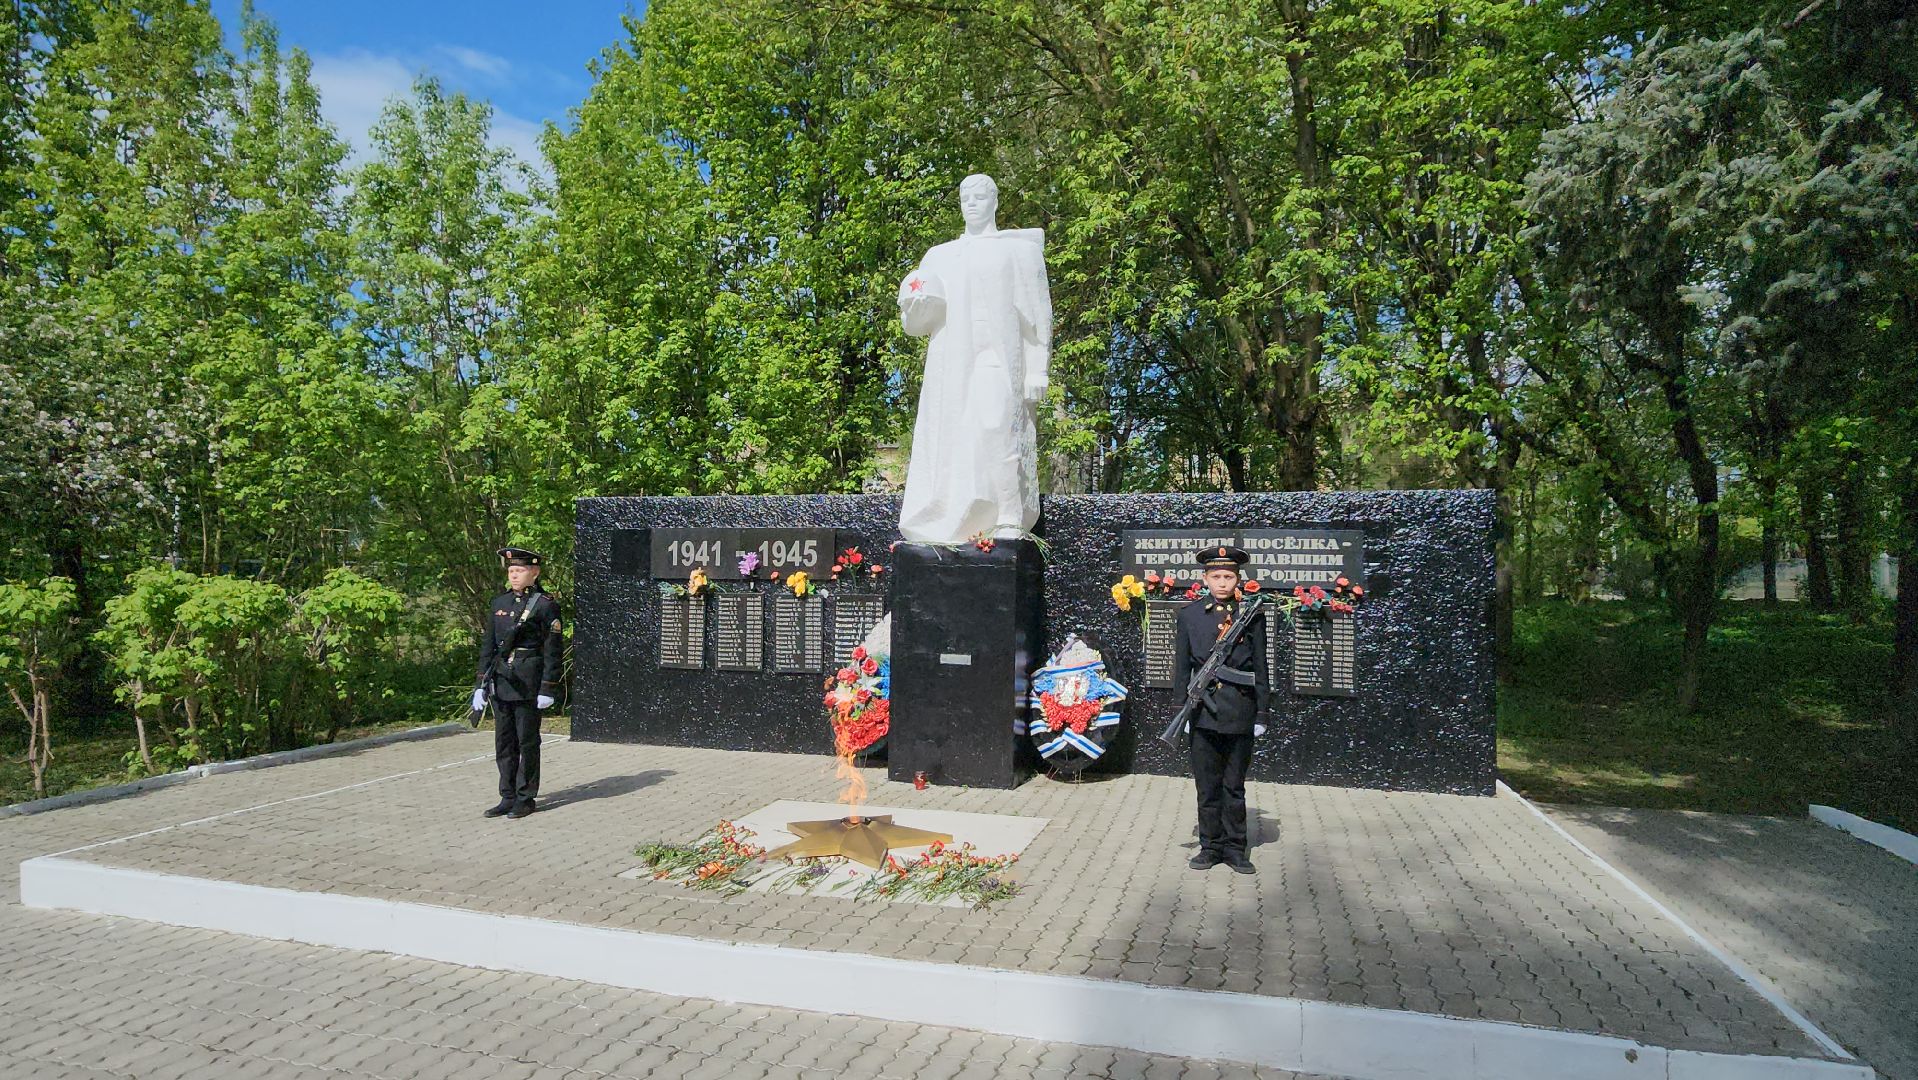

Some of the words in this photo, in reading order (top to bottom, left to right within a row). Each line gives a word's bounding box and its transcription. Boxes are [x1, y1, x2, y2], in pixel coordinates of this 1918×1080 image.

[1135, 538, 1235, 549] ЖИТЕЛЯМ
[668, 540, 722, 567] 1941
[758, 540, 818, 567] 1945
[1135, 551, 1198, 565] ГЕРОЙ
[1250, 553, 1344, 565] ПАВШИМ
[1164, 569, 1205, 580] БОЯ
[1256, 569, 1343, 583] РОДИНУ
